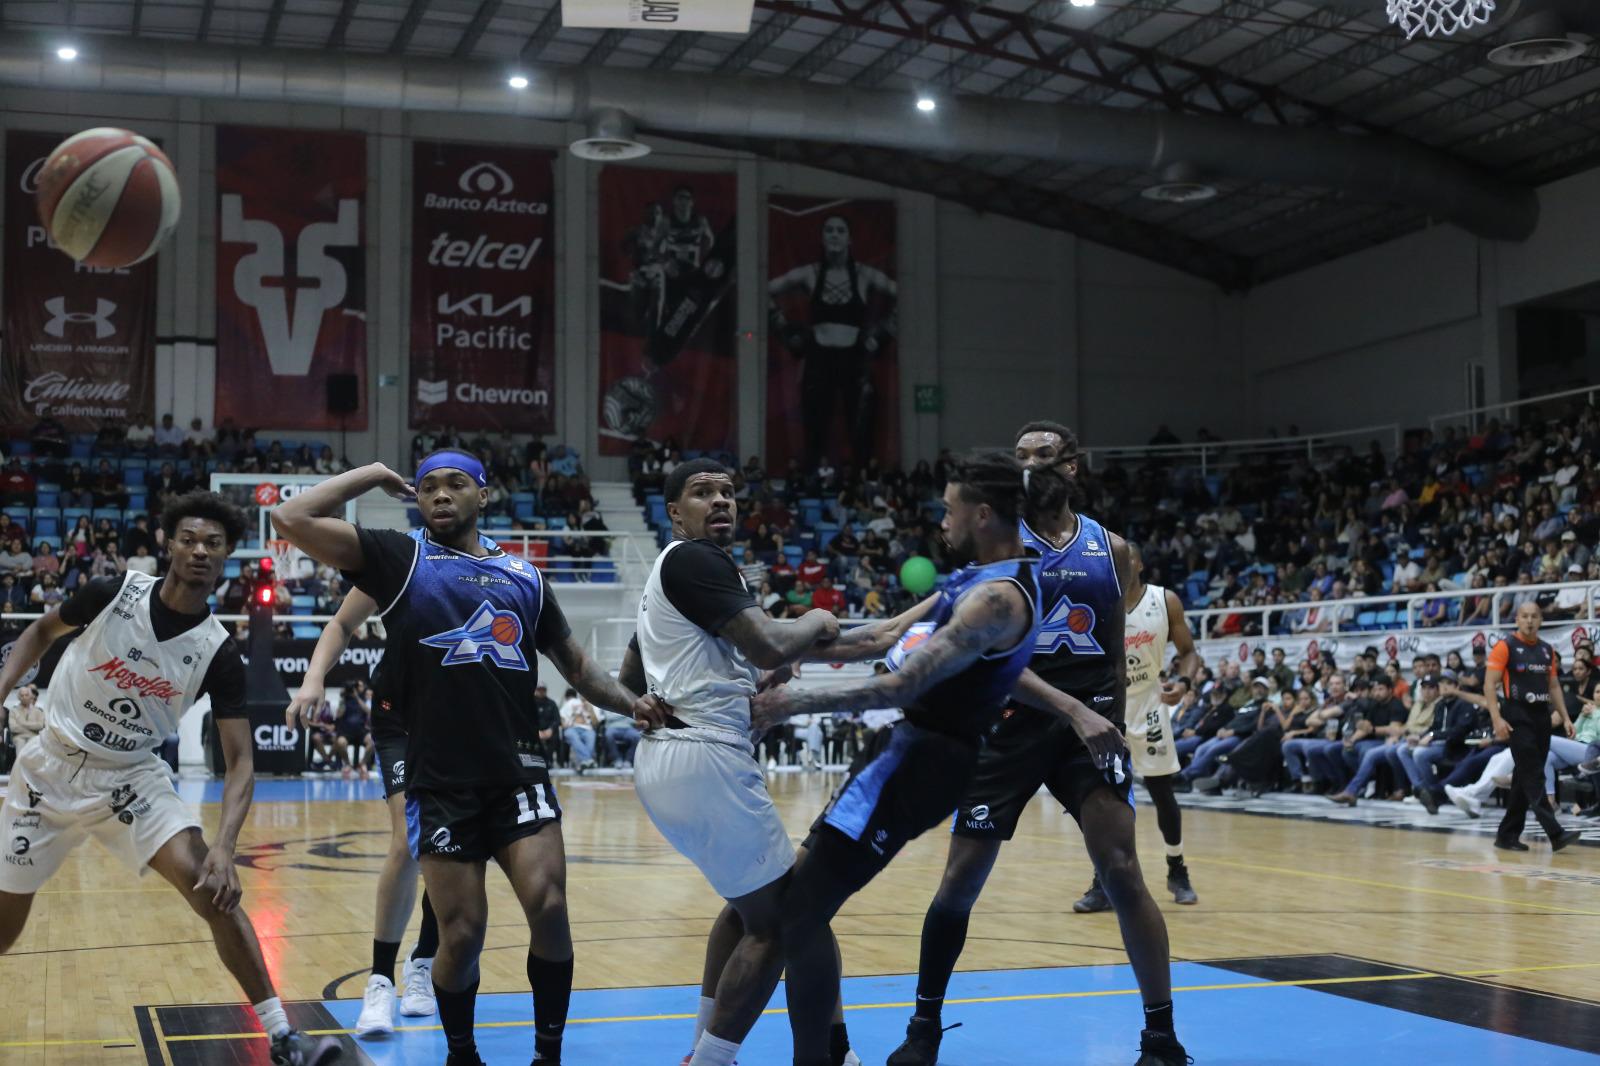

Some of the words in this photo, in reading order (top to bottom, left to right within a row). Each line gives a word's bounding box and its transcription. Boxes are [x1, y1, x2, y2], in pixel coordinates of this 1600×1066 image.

[424, 193, 481, 211] Banco
[484, 197, 548, 214] Azteca
[427, 232, 542, 271] telcel
[436, 323, 532, 350] Pacific
[24, 371, 130, 403] Caliente
[455, 382, 548, 405] Chevron
[51, 404, 127, 417] caliente.mx
[280, 484, 314, 501] CI
[83, 699, 122, 723] Banco
[117, 718, 154, 737] Azteca
[1146, 710, 1160, 726] 55
[254, 724, 299, 746] CID
[391, 776, 406, 787] ME
[515, 783, 556, 824] 11
[966, 820, 995, 830] MEGA
[4, 854, 35, 867] MEGA
